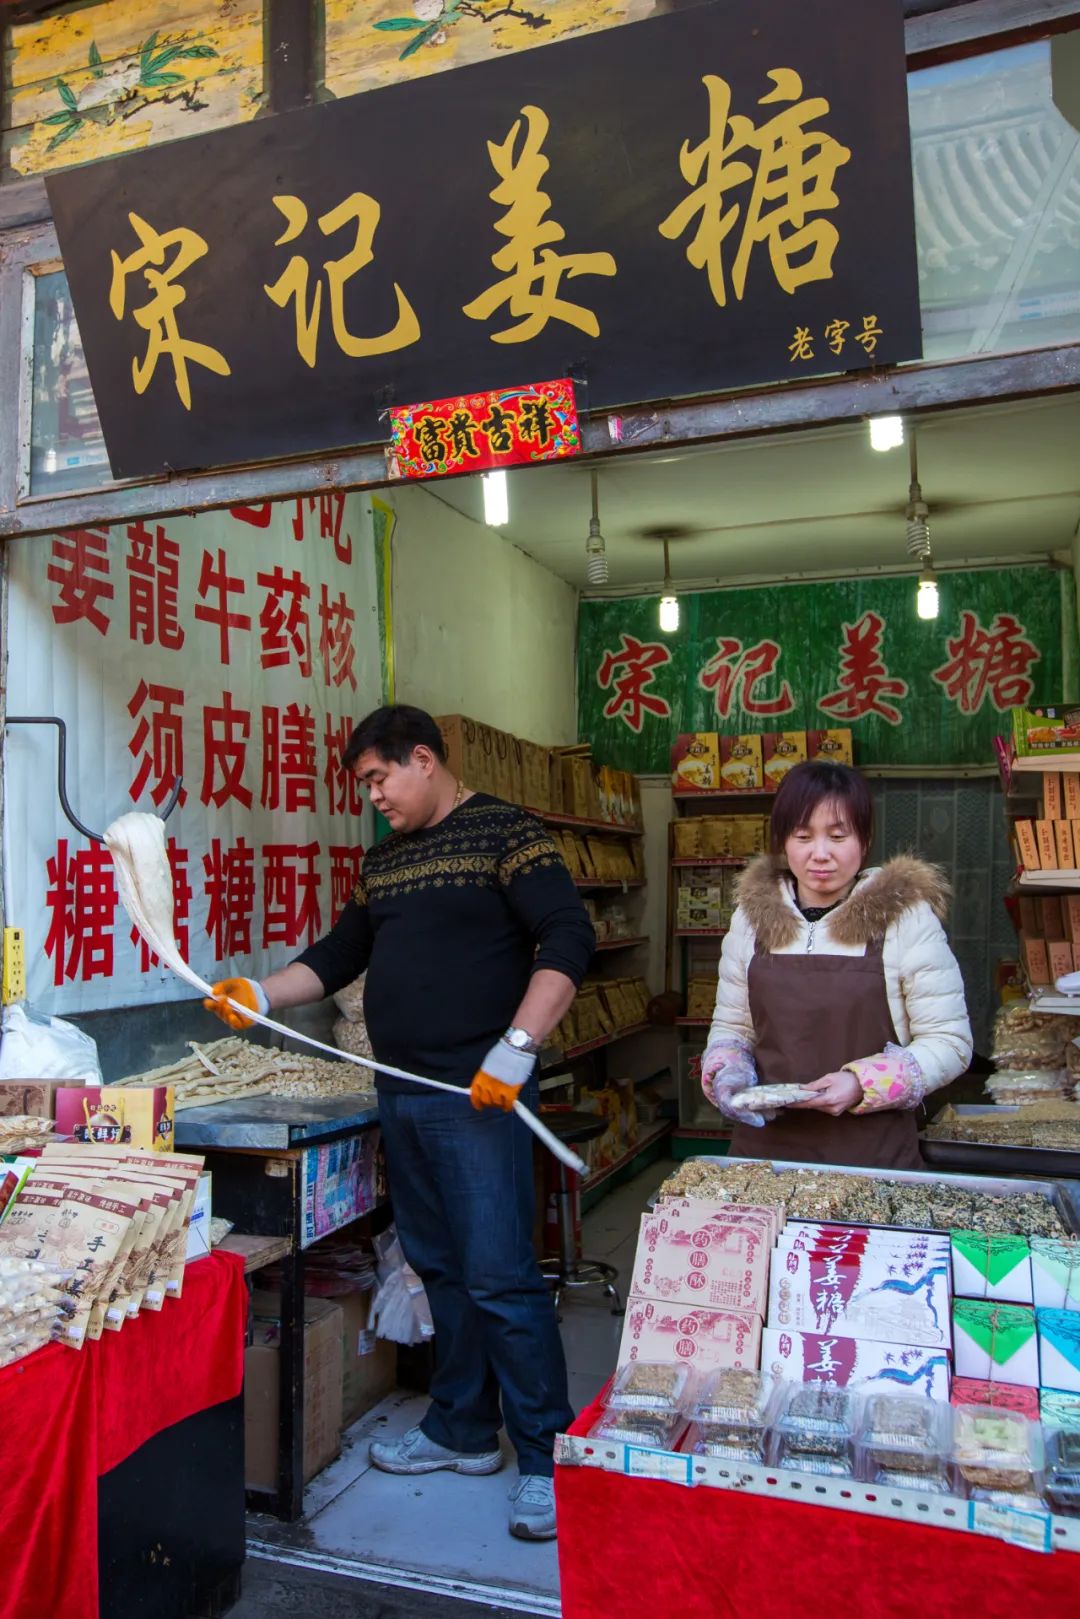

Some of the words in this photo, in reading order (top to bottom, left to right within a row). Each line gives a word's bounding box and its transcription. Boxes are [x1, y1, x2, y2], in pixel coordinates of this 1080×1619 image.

[110, 67, 852, 411] 宋记姜糖
[788, 314, 883, 361] 老字号
[44, 525, 118, 986] 姜糖
[195, 548, 255, 961] 牛皮糖
[257, 565, 321, 949] 药膳酥
[597, 611, 1041, 733] 宋记姜糖
[675, 1315, 699, 1358] 药膳
[813, 1255, 848, 1314] 姜糖
